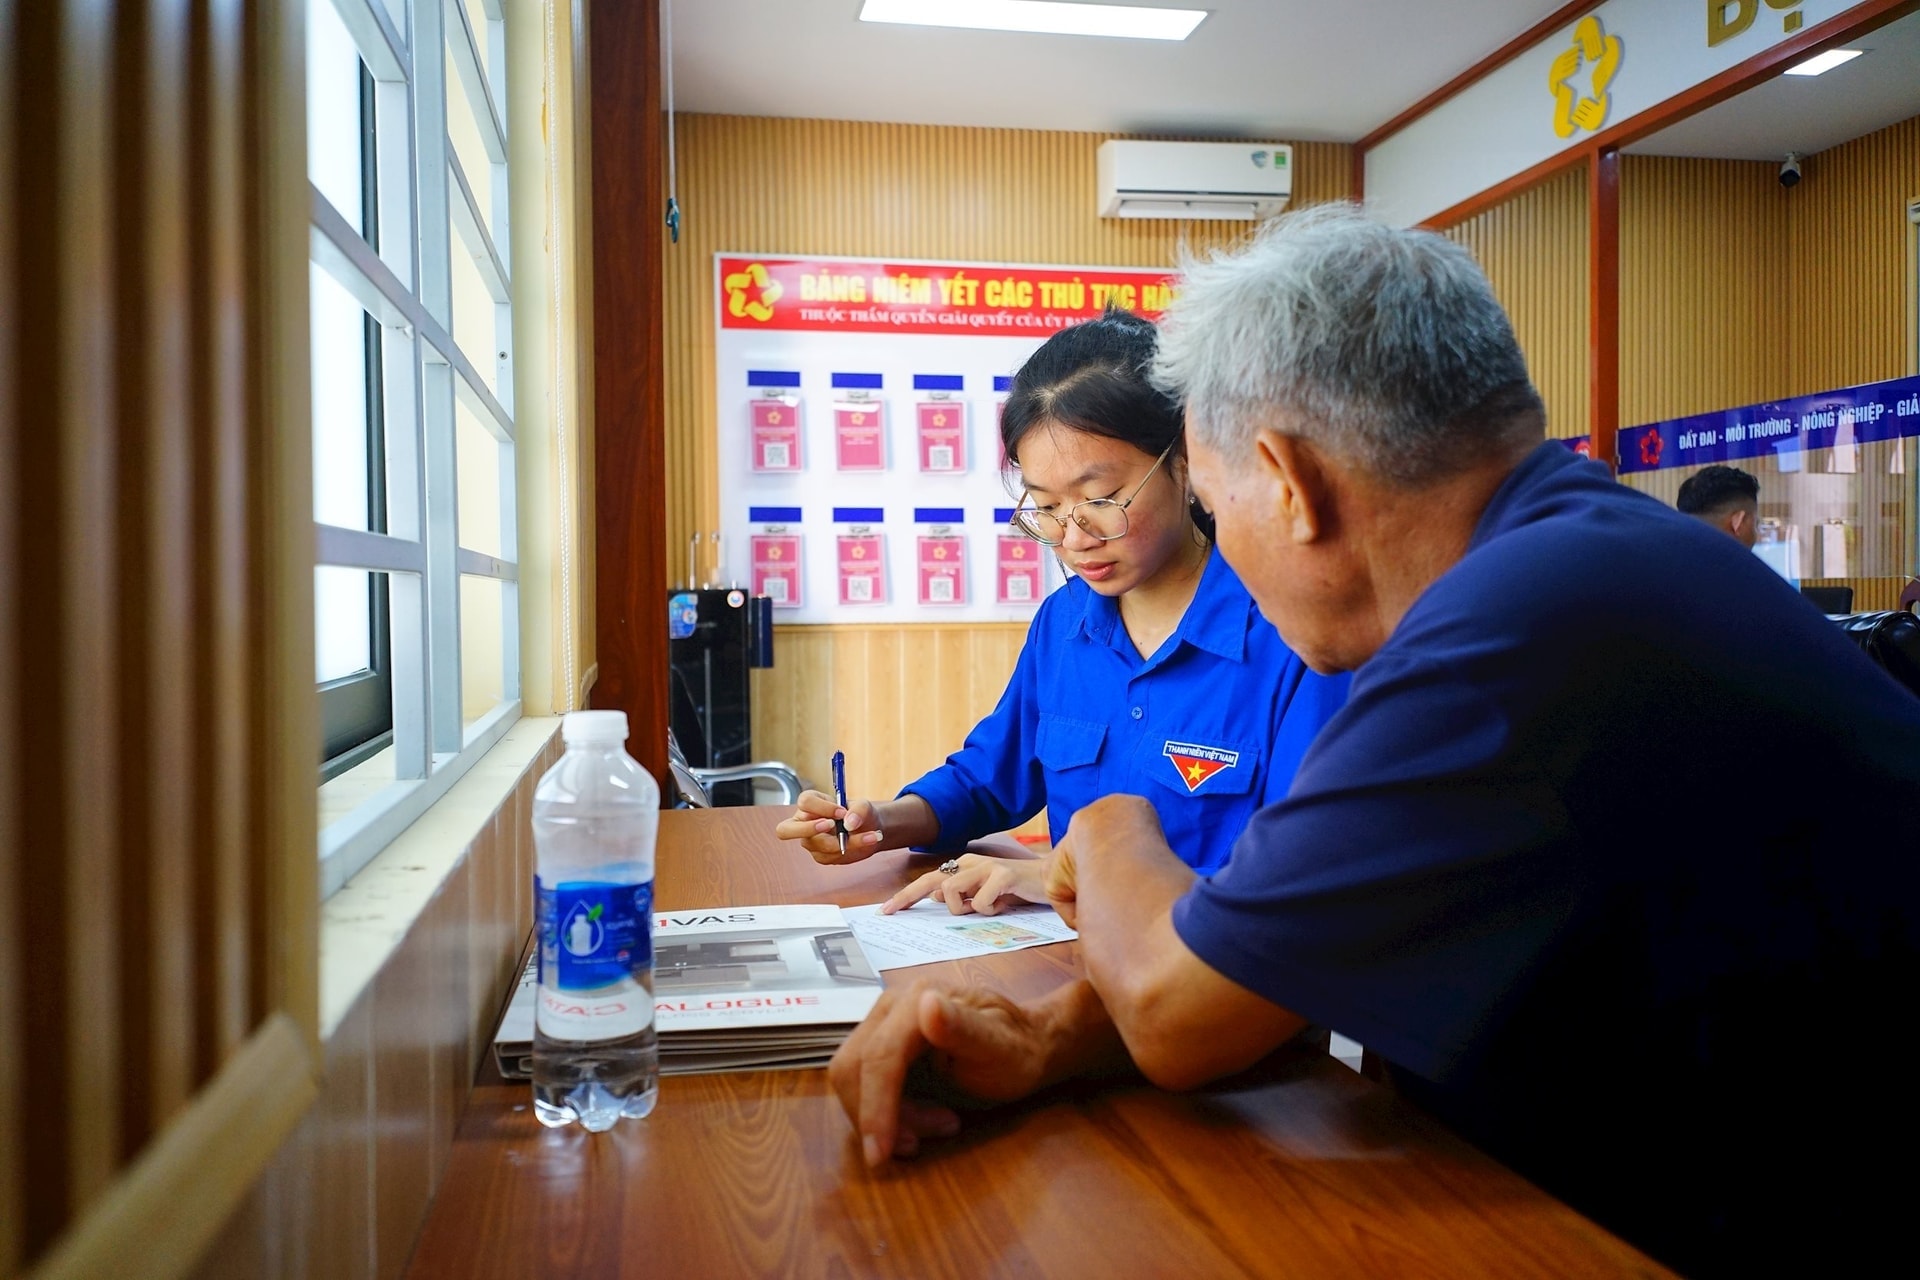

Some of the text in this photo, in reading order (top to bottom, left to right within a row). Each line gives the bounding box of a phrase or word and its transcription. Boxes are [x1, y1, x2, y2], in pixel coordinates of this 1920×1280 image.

[800, 269, 866, 302] BẢNG
[873, 273, 931, 304] NIÊM
[938, 271, 979, 306] YẾT
[984, 277, 1033, 308] CÁC
[1038, 277, 1085, 310] THỦ
[1142, 282, 1182, 311] HÀ
[800, 307, 846, 323] THUỘC
[1699, 430, 1716, 447] ĐAI
[1725, 422, 1746, 443] MÔI
[1748, 417, 1791, 439] TRƯỜNG
[1802, 411, 1835, 431] NÔNG
[1838, 402, 1884, 424] NGHIỆP
[1897, 393, 1920, 417] GIẢ
[1168, 745, 1188, 755] THANH
[1204, 750, 1219, 760] VIỆT
[1219, 753, 1235, 763] NAM
[655, 996, 819, 1011] ALOGUE
